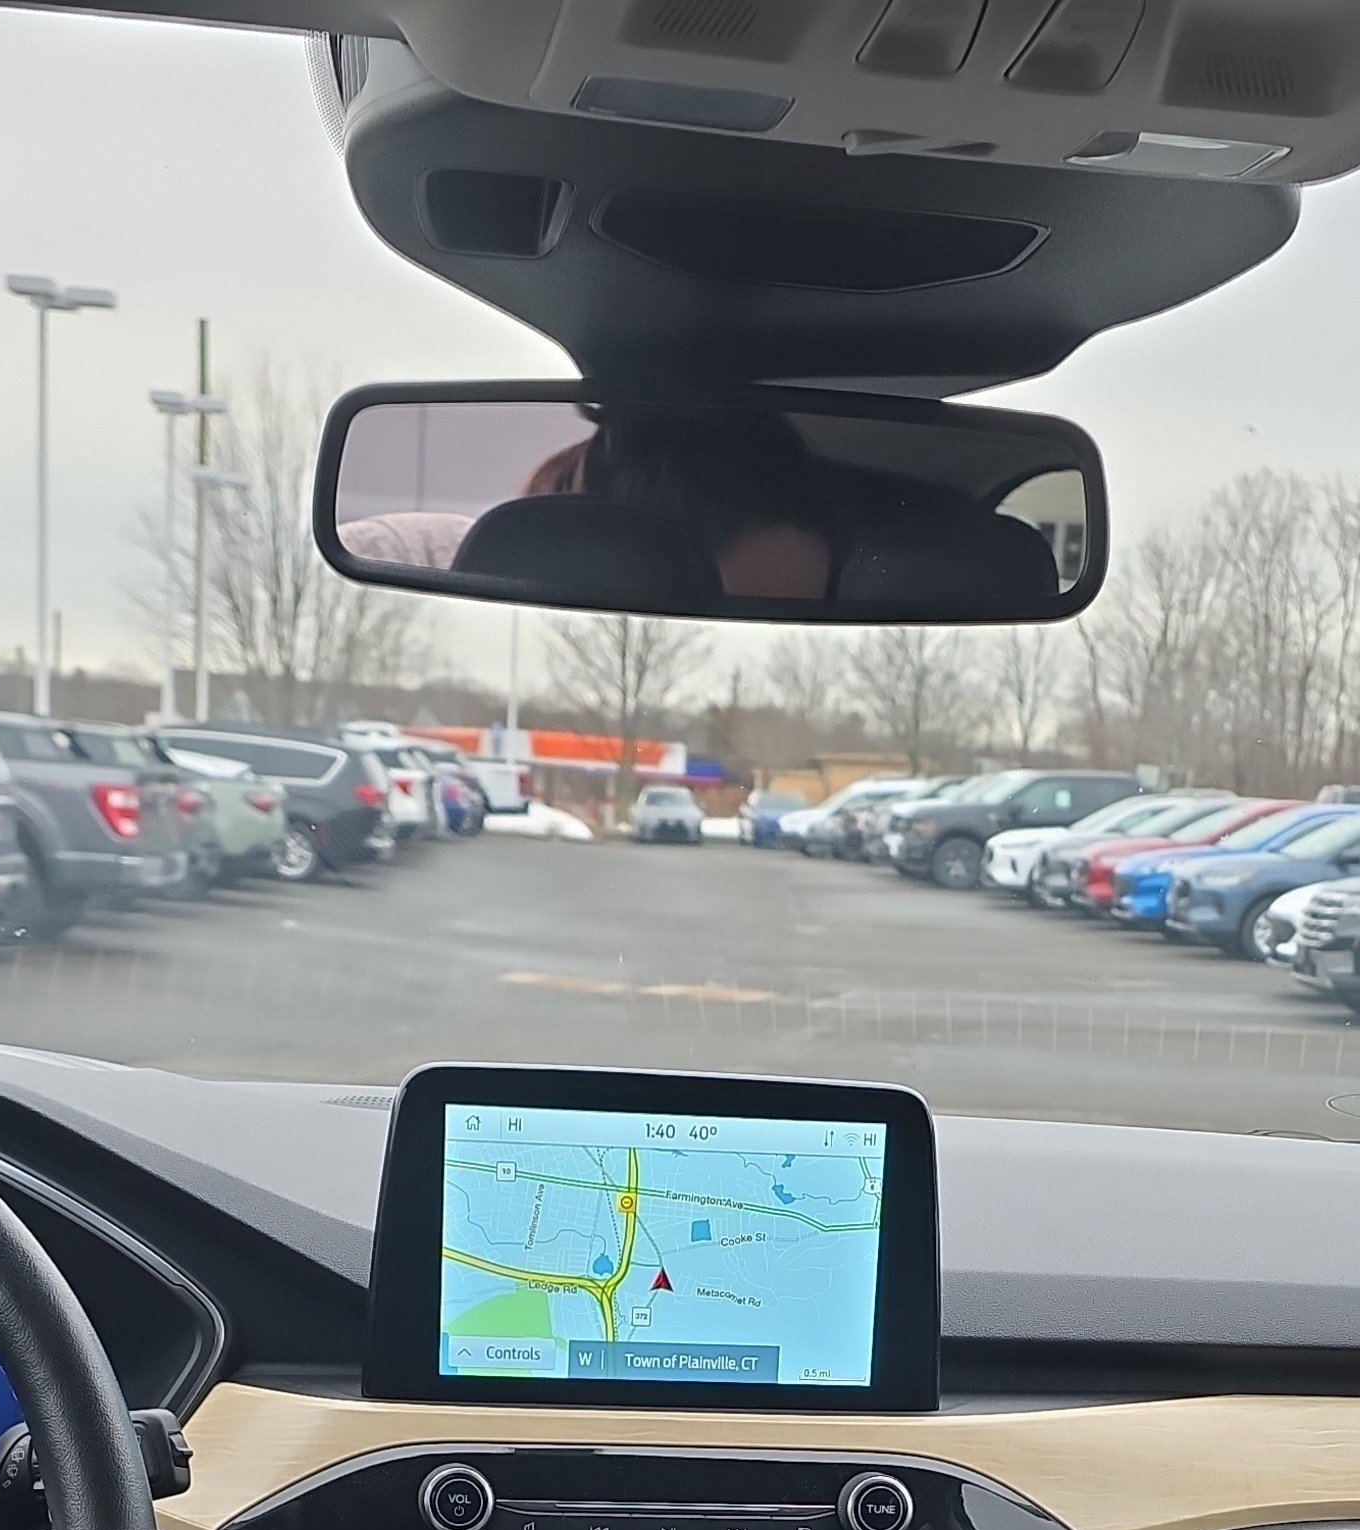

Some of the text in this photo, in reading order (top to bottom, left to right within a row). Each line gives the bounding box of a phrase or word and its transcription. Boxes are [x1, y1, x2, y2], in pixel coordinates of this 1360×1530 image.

[507, 1117, 523, 1132] HI
[645, 1122, 676, 1139] 1:40
[863, 1133, 877, 1147] HI
[665, 1190, 743, 1210] Farmington Ave
[524, 1183, 545, 1251] Tomlinson Ave
[720, 1231, 767, 1247] Cooke St
[528, 1280, 578, 1295] Ledge Rd
[696, 1287, 762, 1308] Metacomet Rd
[635, 1312, 648, 1321] 372
[486, 1345, 541, 1361] Controls
[577, 1353, 593, 1366] W
[624, 1353, 759, 1372] Town of Plainville, CT
[803, 1369, 831, 1379] 0.5 mi
[447, 1493, 472, 1505] VOL
[866, 1503, 896, 1516] TUNE
